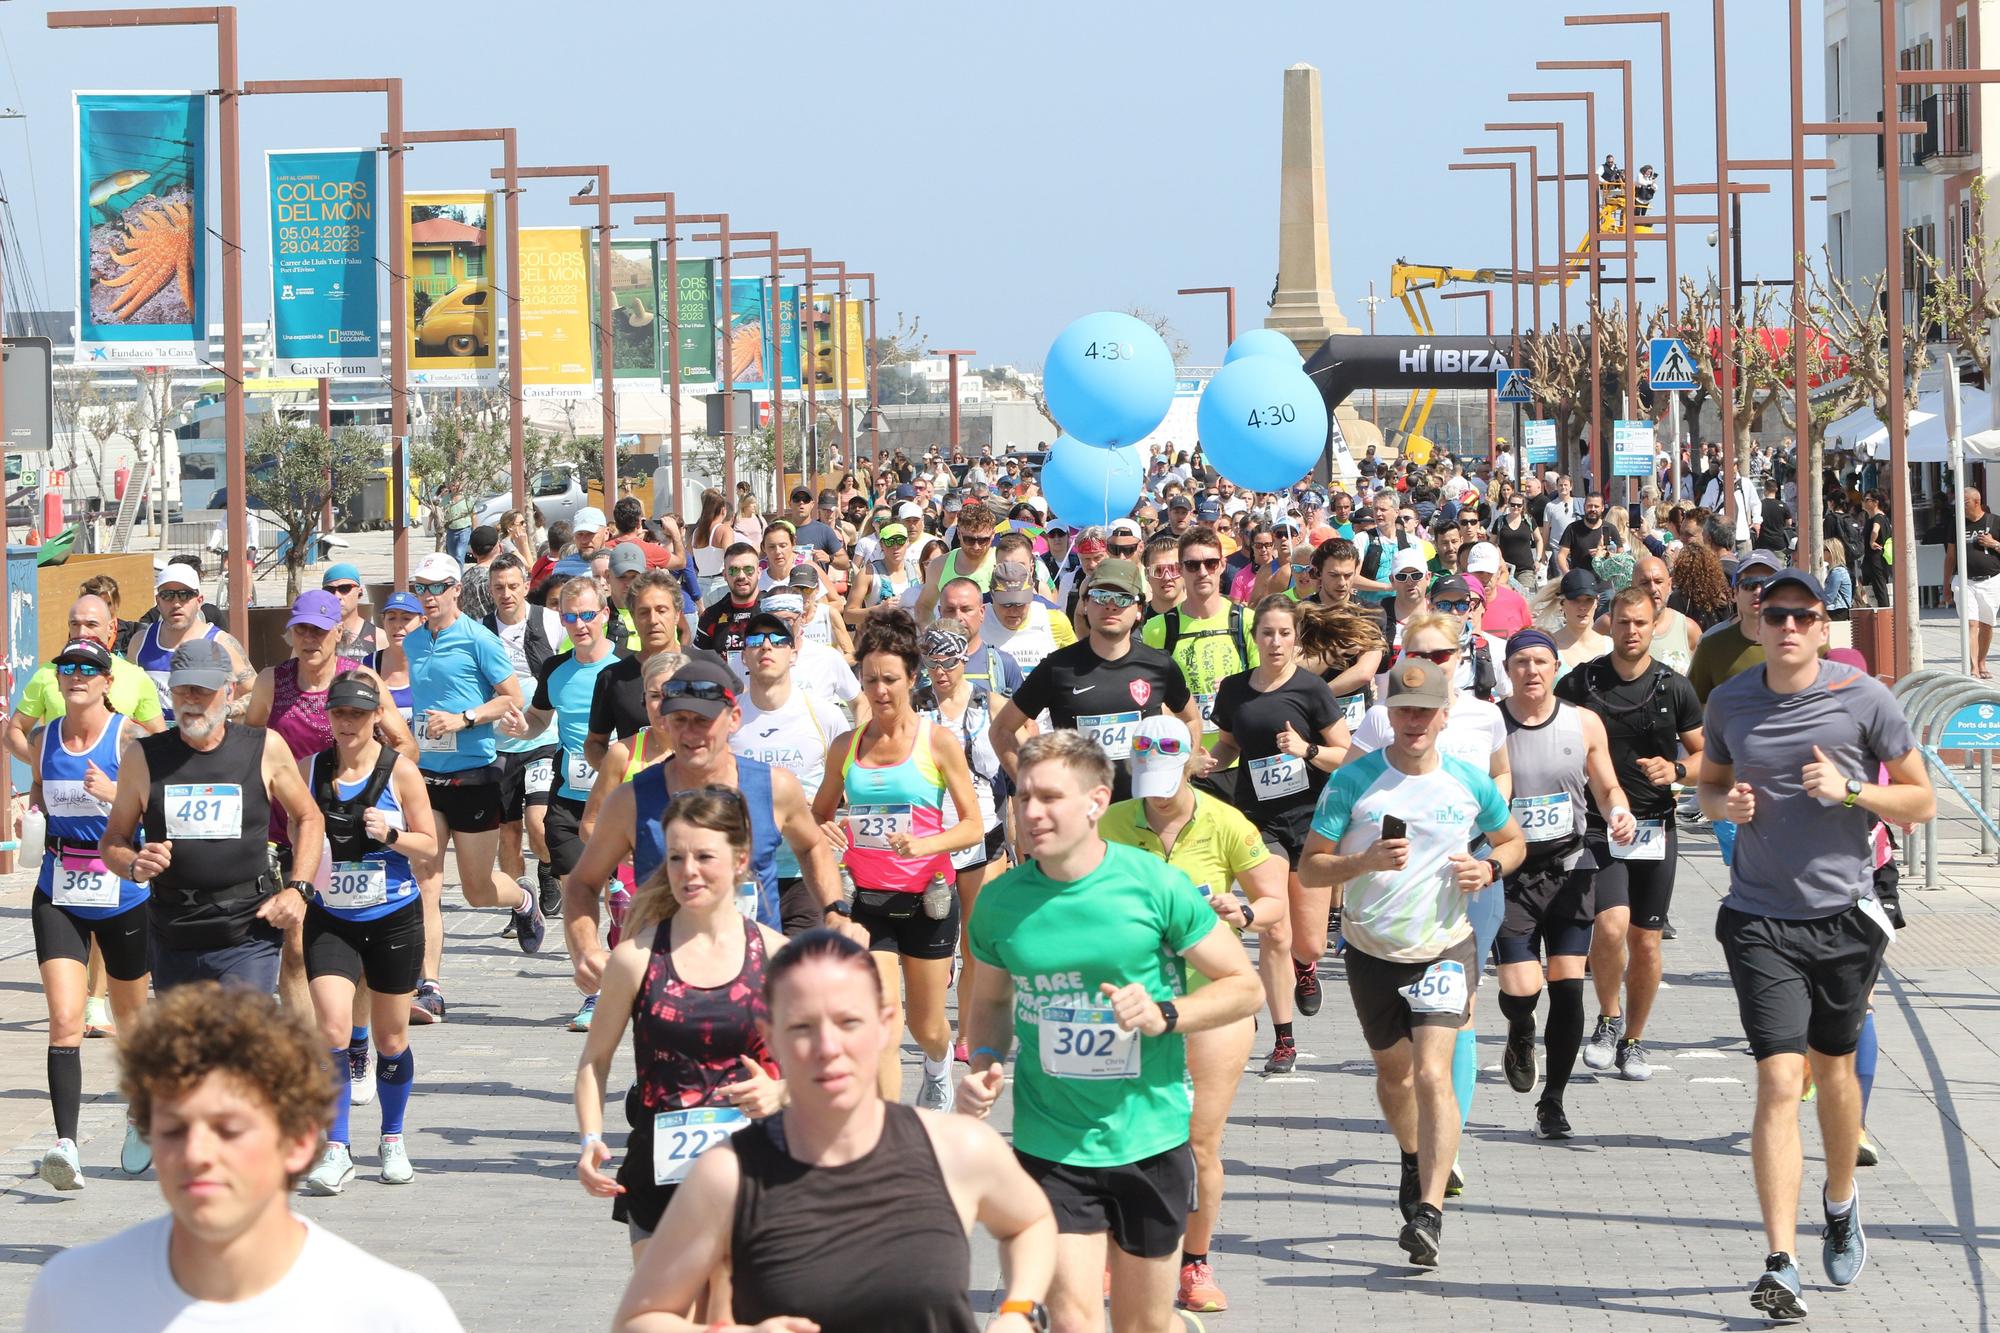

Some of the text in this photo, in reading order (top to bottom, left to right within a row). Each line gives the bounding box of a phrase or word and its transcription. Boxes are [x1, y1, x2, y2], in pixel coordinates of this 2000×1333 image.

[277, 181, 367, 202] COLORS
[278, 200, 371, 223] DEL MÓN
[279, 225, 366, 240] 05.04.2023-
[280, 239, 360, 254] 29.04.2023
[328, 258, 340, 266] Tur
[519, 251, 584, 267] COLORS
[661, 277, 707, 290] CORS
[111, 347, 153, 358] Fundació
[1084, 341, 1134, 360] 4:30
[290, 361, 366, 376] CaixaForum
[1434, 349, 1510, 373] IBIZA
[430, 372, 460, 381] Fundació
[523, 387, 582, 397] CaixaForum
[1247, 402, 1296, 429] 4:30
[1957, 721, 1977, 729] Ports
[1977, 721, 1987, 729] de
[1089, 726, 1127, 746] 264
[759, 750, 804, 763] IBIZA
[766, 760, 806, 769] ARATHON
[1261, 765, 1293, 787] 452
[176, 799, 223, 822] 481
[1521, 806, 1560, 829] 236
[859, 817, 898, 837] 233
[62, 870, 103, 891] 365
[328, 874, 369, 895] 308
[1035, 971, 1084, 993] ARE
[1408, 975, 1451, 998] 450
[1053, 1027, 1117, 1057] 302
[1105, 1057, 1126, 1065] Chris
